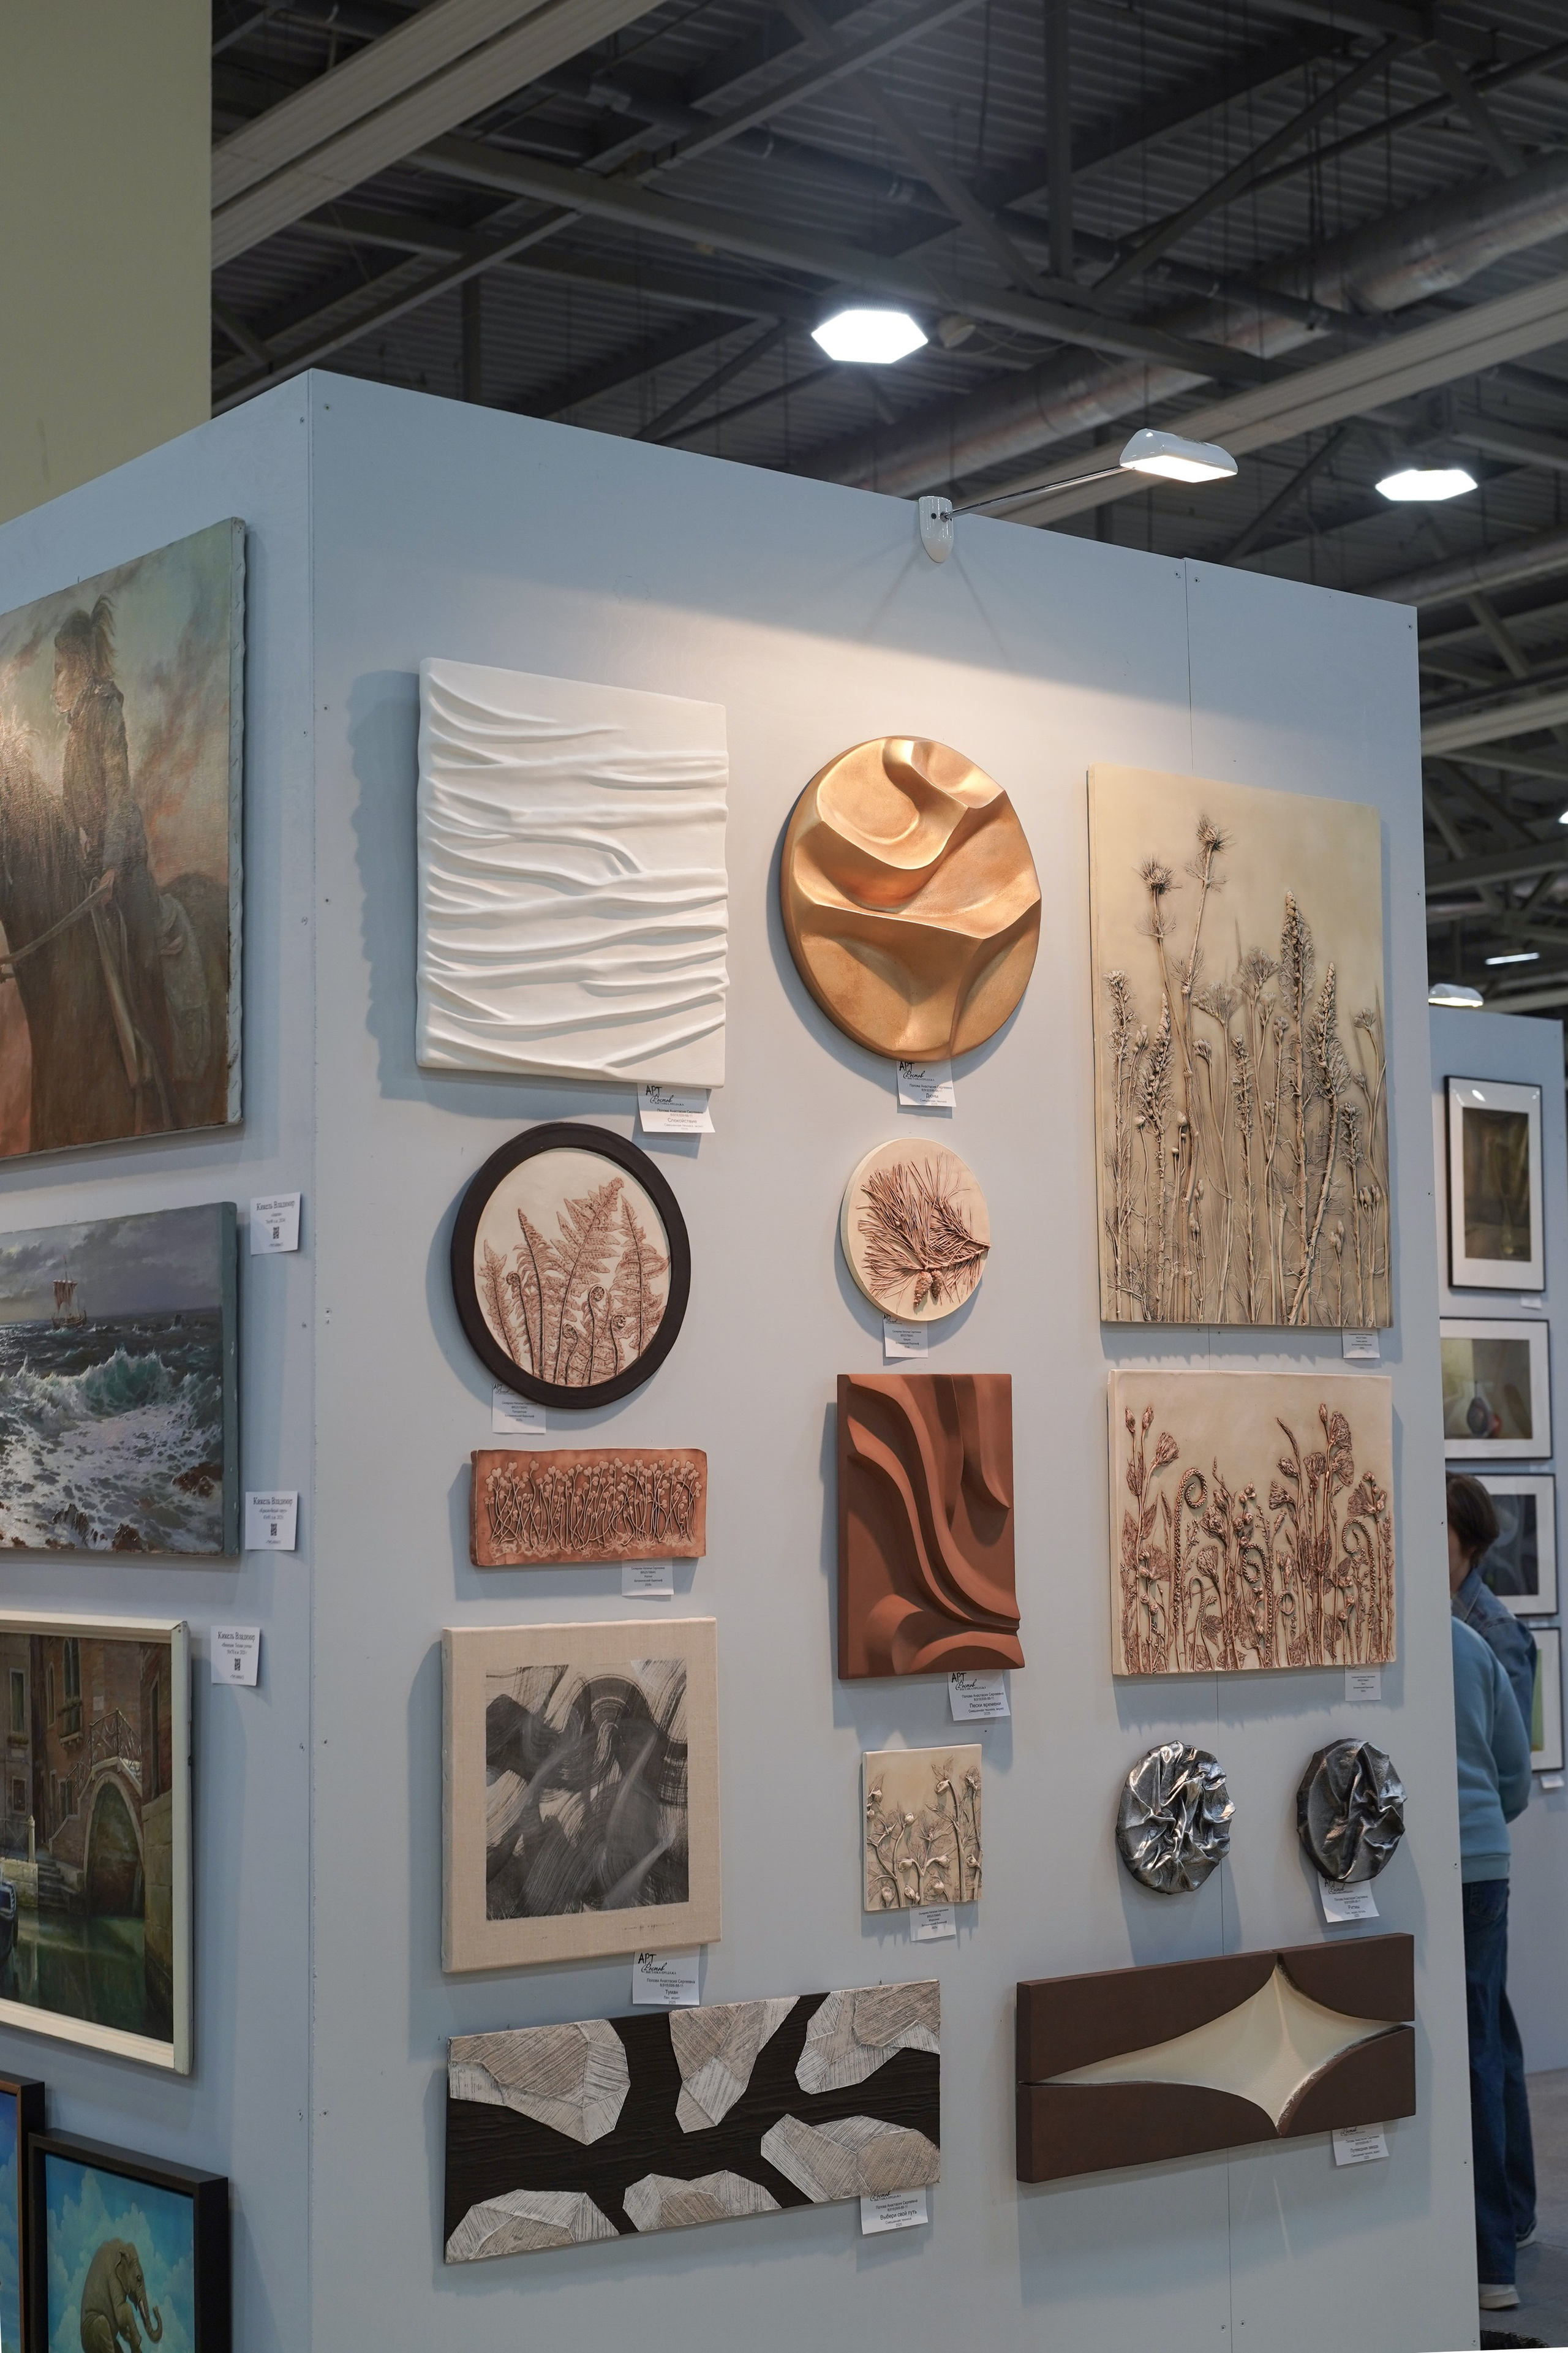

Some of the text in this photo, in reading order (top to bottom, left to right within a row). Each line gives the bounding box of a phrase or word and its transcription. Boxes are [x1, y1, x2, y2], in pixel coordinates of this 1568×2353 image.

[899, 1062, 914, 1071] АРТ
[903, 1070, 925, 1079] Ростов
[646, 1085, 662, 1095] АРТ
[650, 1093, 674, 1103] Ростов
[952, 1672, 967, 1683] АРТ
[956, 1679, 976, 1690] Ростов
[638, 1953, 657, 1964] АРТ
[641, 1962, 667, 1973] Ростов
